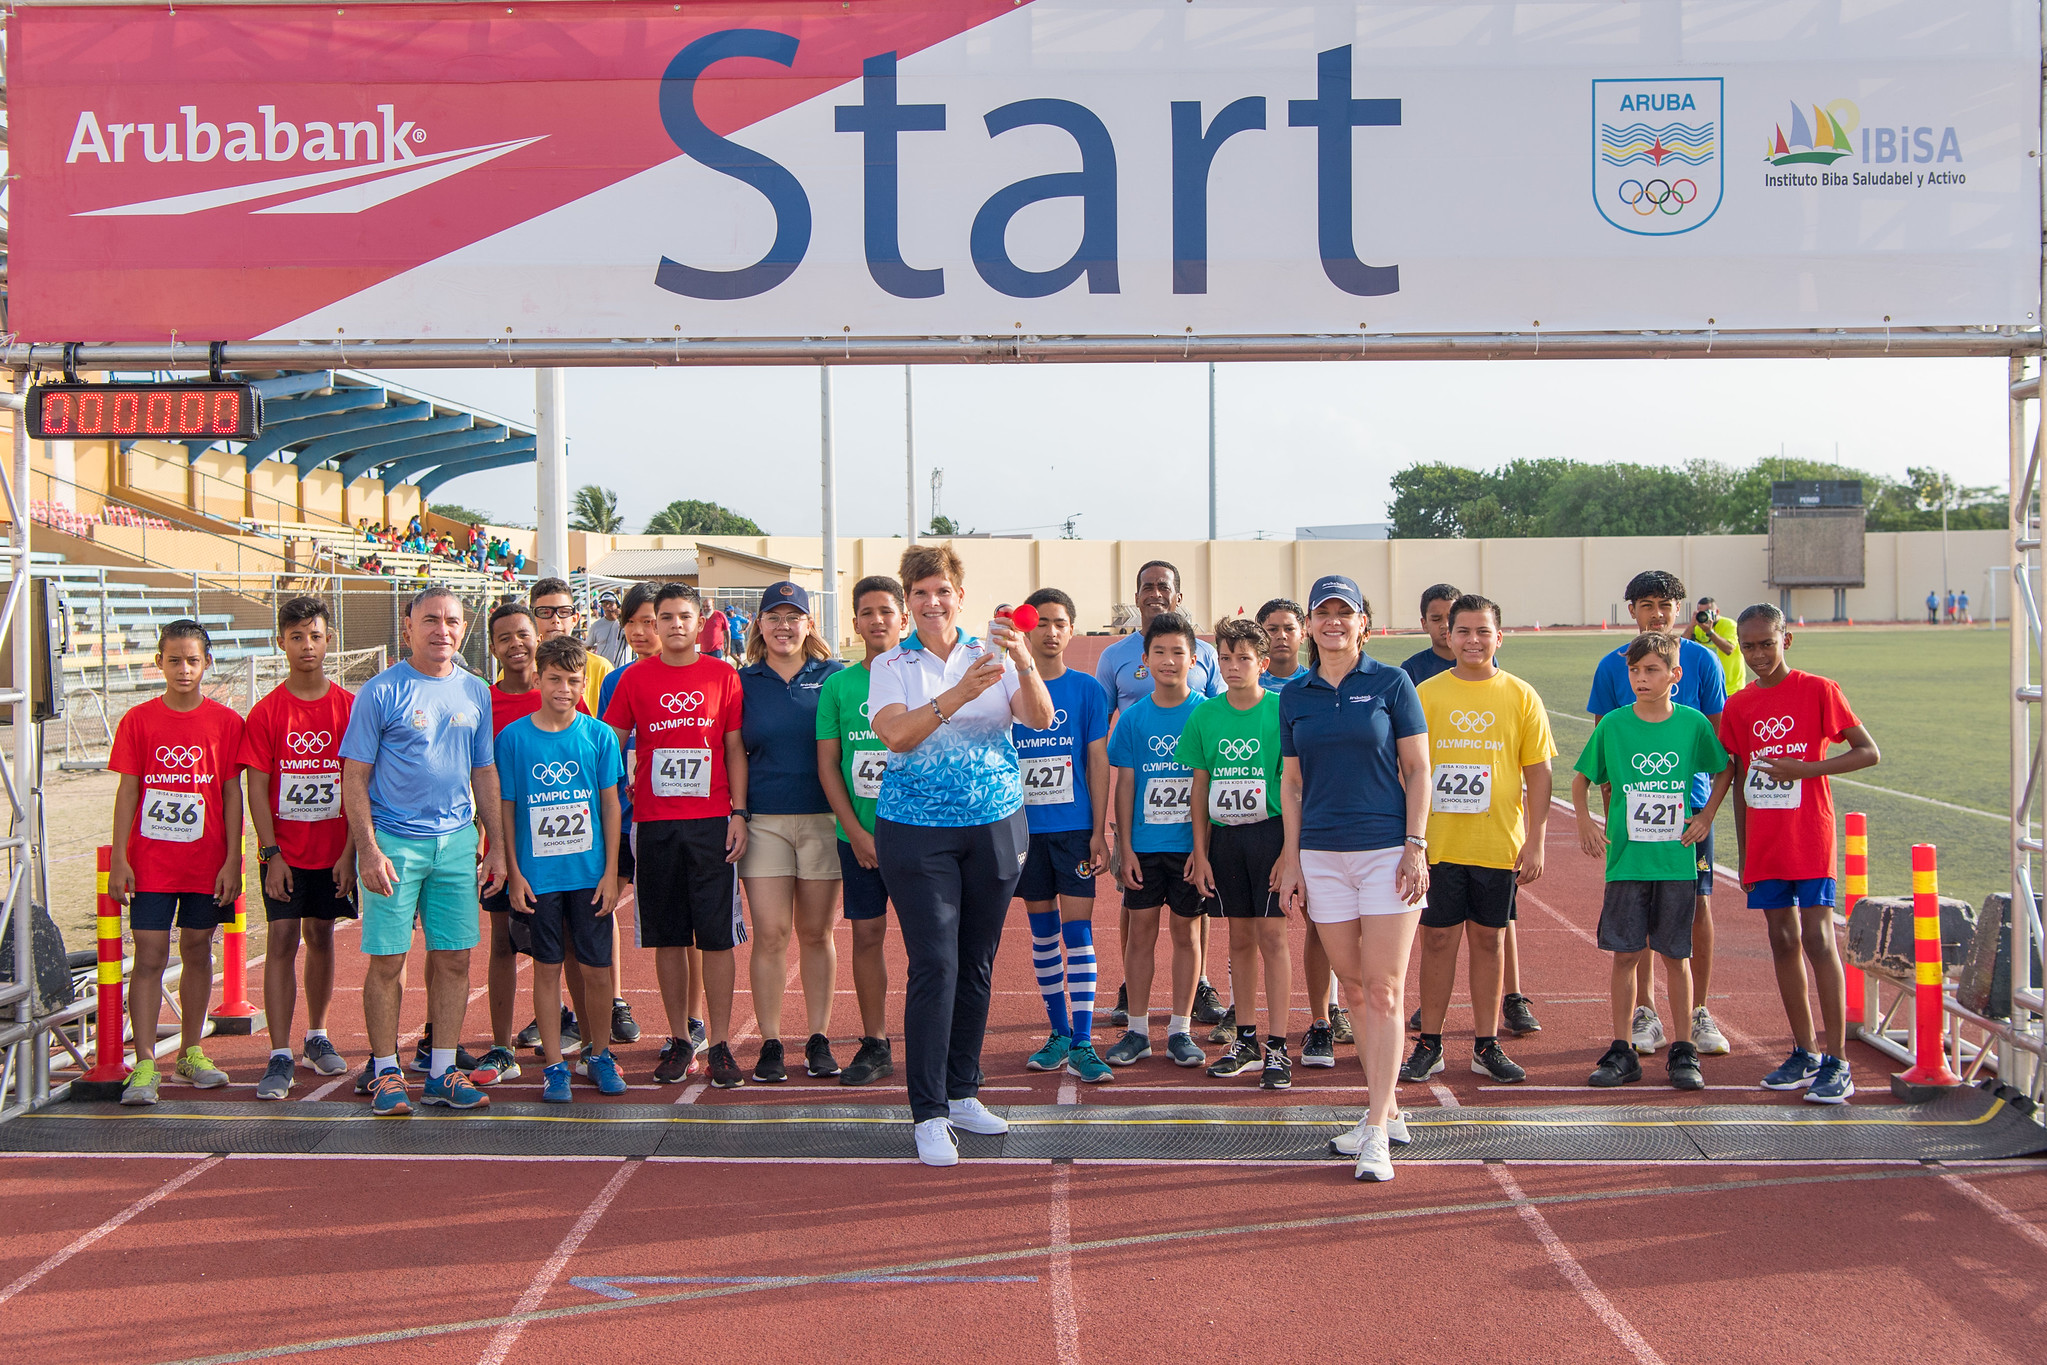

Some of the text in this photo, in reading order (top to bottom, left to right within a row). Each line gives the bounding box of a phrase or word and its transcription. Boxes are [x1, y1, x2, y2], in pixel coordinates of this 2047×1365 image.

[1620, 93, 1696, 112] ARUBA
[1862, 126, 1963, 164] IBiSA
[654, 29, 1402, 300] Start
[1765, 171, 1966, 188] Instituto Biba Saludabel y Activo
[649, 717, 694, 733] OLYMPIC
[697, 717, 715, 728] DAY
[848, 730, 879, 741] OLYM
[1436, 739, 1504, 751] OLYMPIC DAY
[1786, 742, 1808, 754] DAY
[144, 774, 214, 784] OLYMPIC DAY
[660, 758, 702, 780] 417
[1024, 765, 1065, 789] 427
[286, 783, 335, 805] 423
[573, 789, 593, 799] DAY
[1436, 773, 1485, 796] 426
[1622, 780, 1686, 794] OLYMPIC DA
[1149, 787, 1191, 807] 424
[1216, 789, 1257, 810] 416
[147, 800, 198, 825] 436
[1633, 802, 1677, 825] 421
[538, 813, 586, 838] 422
